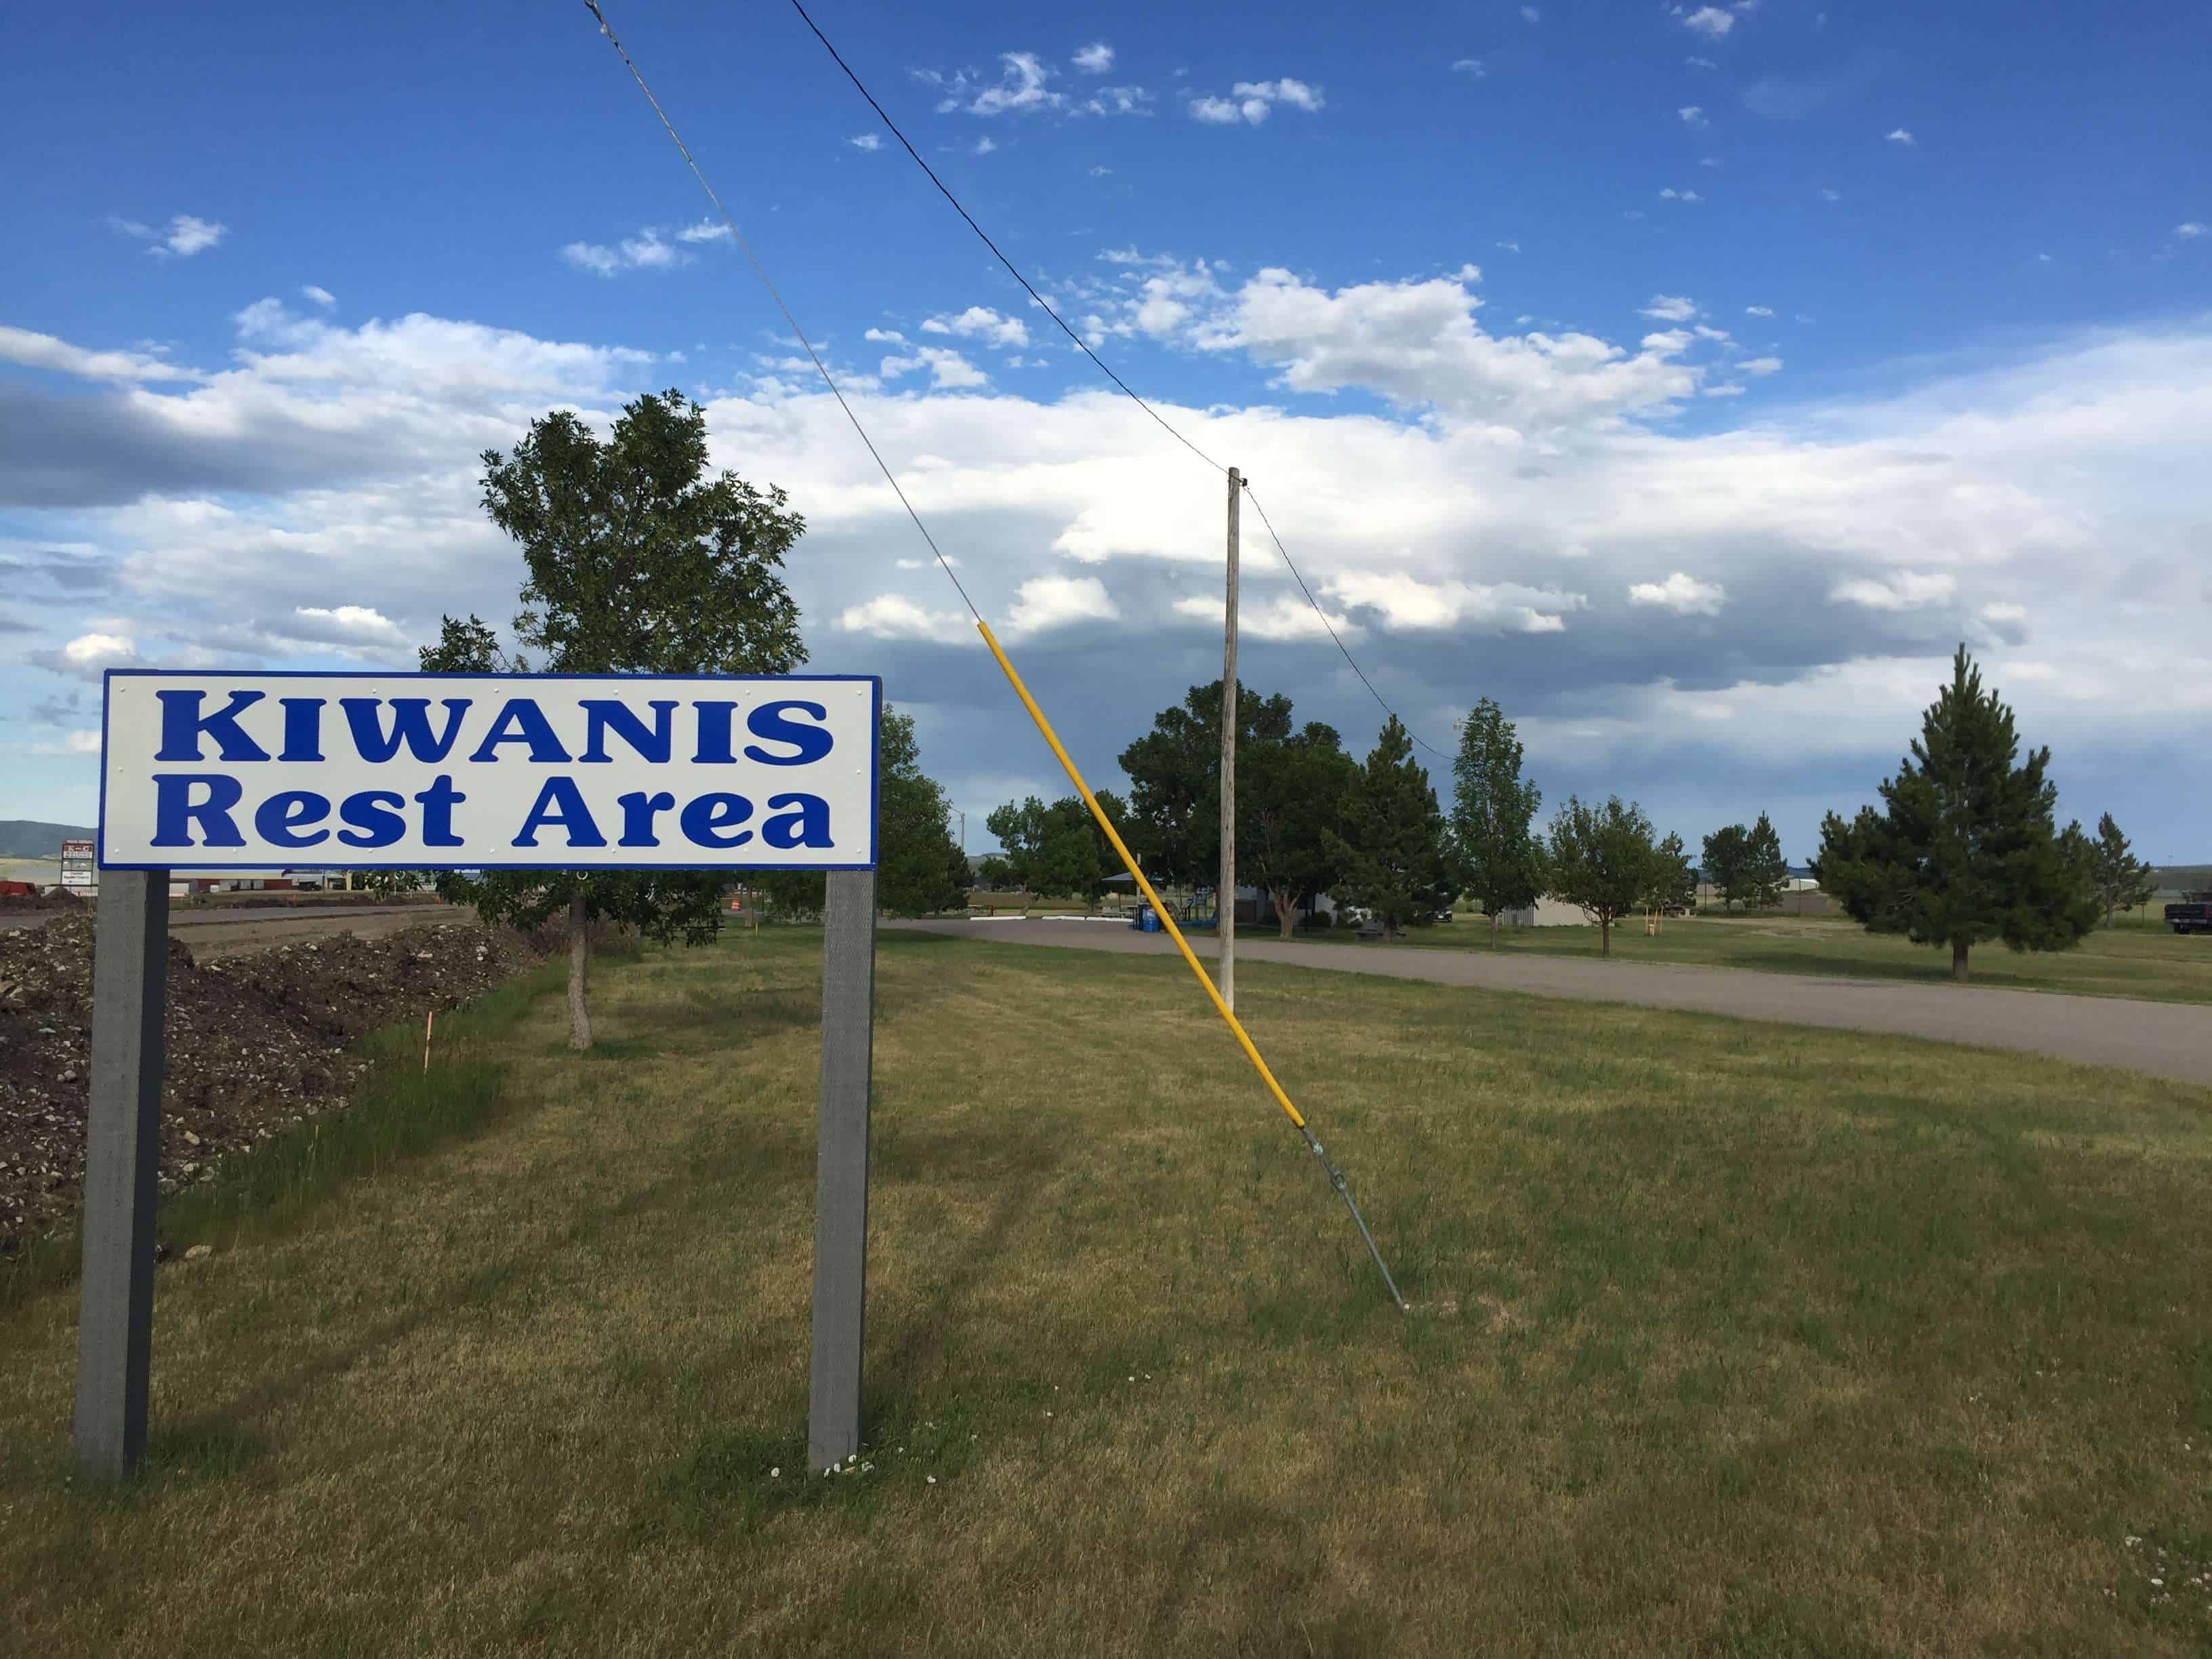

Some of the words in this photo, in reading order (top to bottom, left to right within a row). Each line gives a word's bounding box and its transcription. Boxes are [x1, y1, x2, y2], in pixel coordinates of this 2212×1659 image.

[156, 691, 833, 766] KIWANIS
[151, 774, 466, 848] Rest
[512, 777, 833, 848] Area
